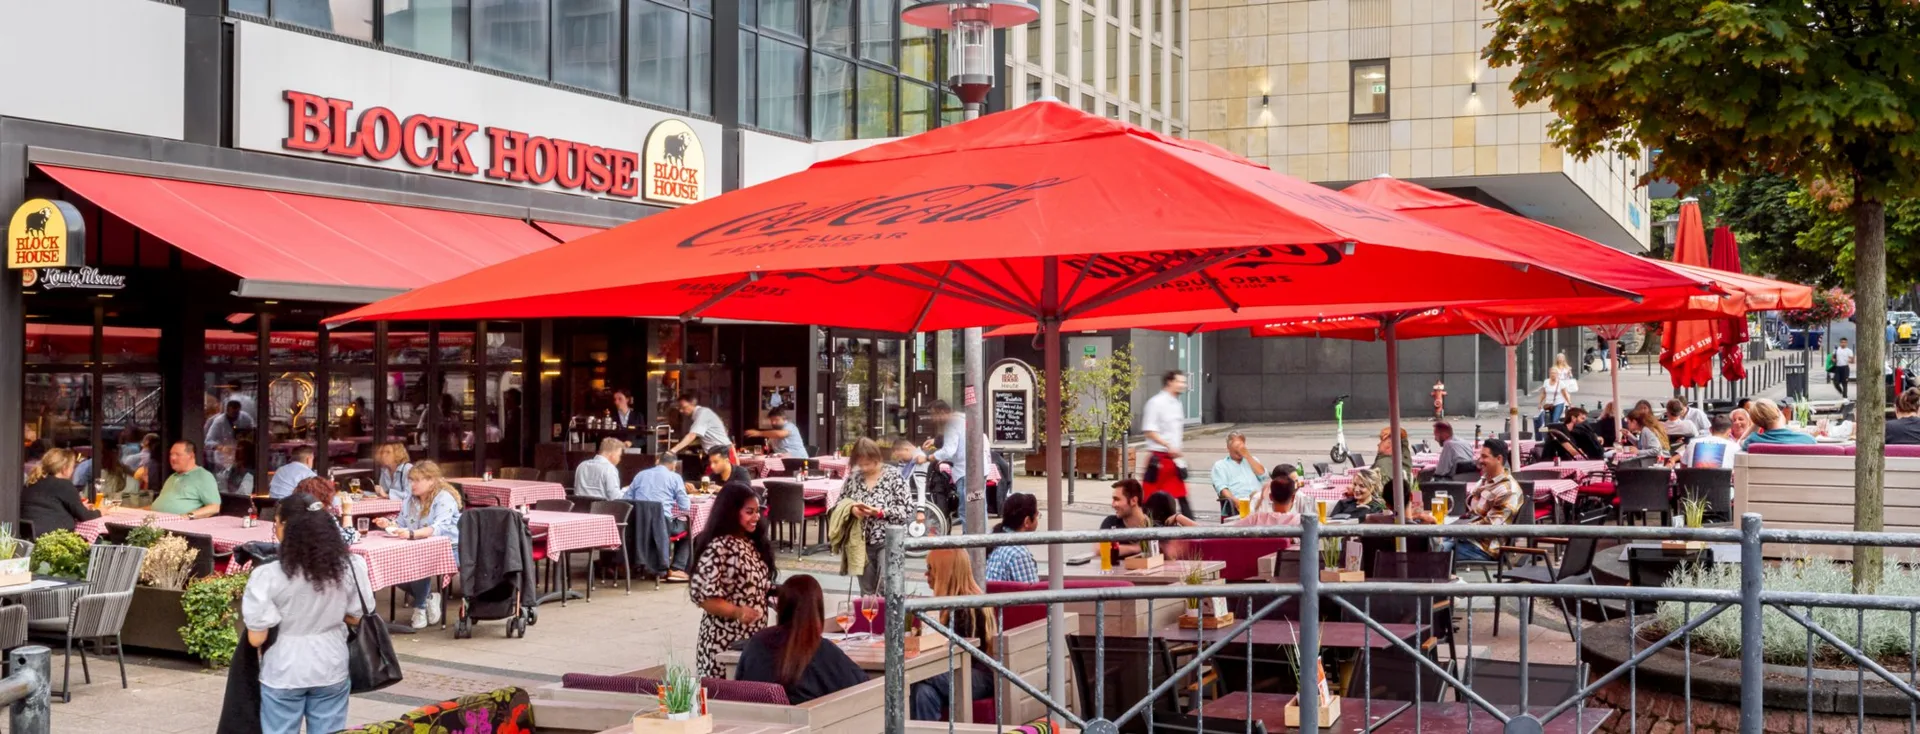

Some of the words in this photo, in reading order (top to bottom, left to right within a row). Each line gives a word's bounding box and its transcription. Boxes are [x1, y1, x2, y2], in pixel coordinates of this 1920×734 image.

[282, 90, 479, 175] BLOCK
[484, 126, 639, 197] HOUSE
[654, 162, 698, 184] BLOCK
[654, 179, 698, 200] HOUSE
[16, 236, 59, 250] BLOCK
[801, 232, 907, 243] SUGAR
[15, 250, 59, 264] HOUSE
[41, 267, 80, 288] König
[80, 266, 125, 287] Pilsener
